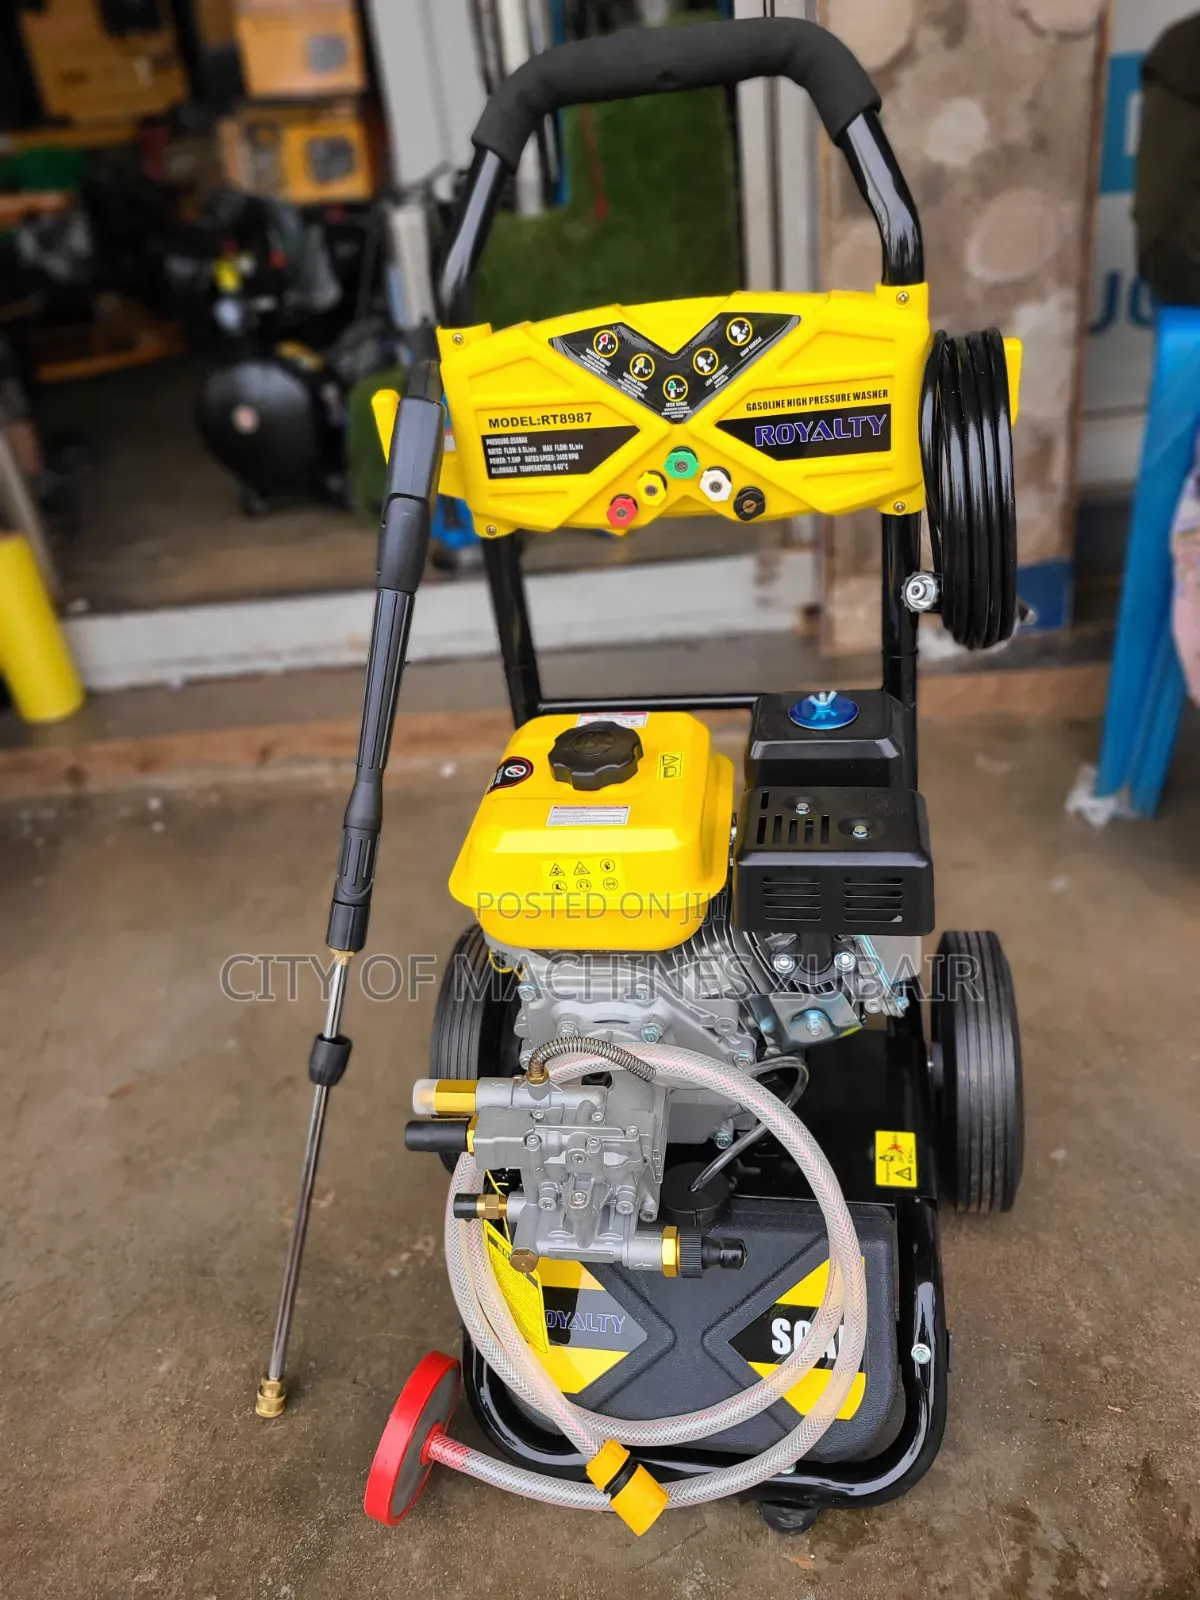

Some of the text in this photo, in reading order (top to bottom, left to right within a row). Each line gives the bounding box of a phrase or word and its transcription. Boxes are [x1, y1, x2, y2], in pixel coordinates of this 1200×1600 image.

[746, 389, 888, 411] GASOLINE HIGH PRESSURE WASHER
[488, 412, 592, 429] MODEL:RT8987
[754, 413, 887, 447] ROYALTY
[542, 444, 553, 452] MAX
[544, 1309, 626, 1334] OYALTY
[771, 1317, 845, 1359] SO
